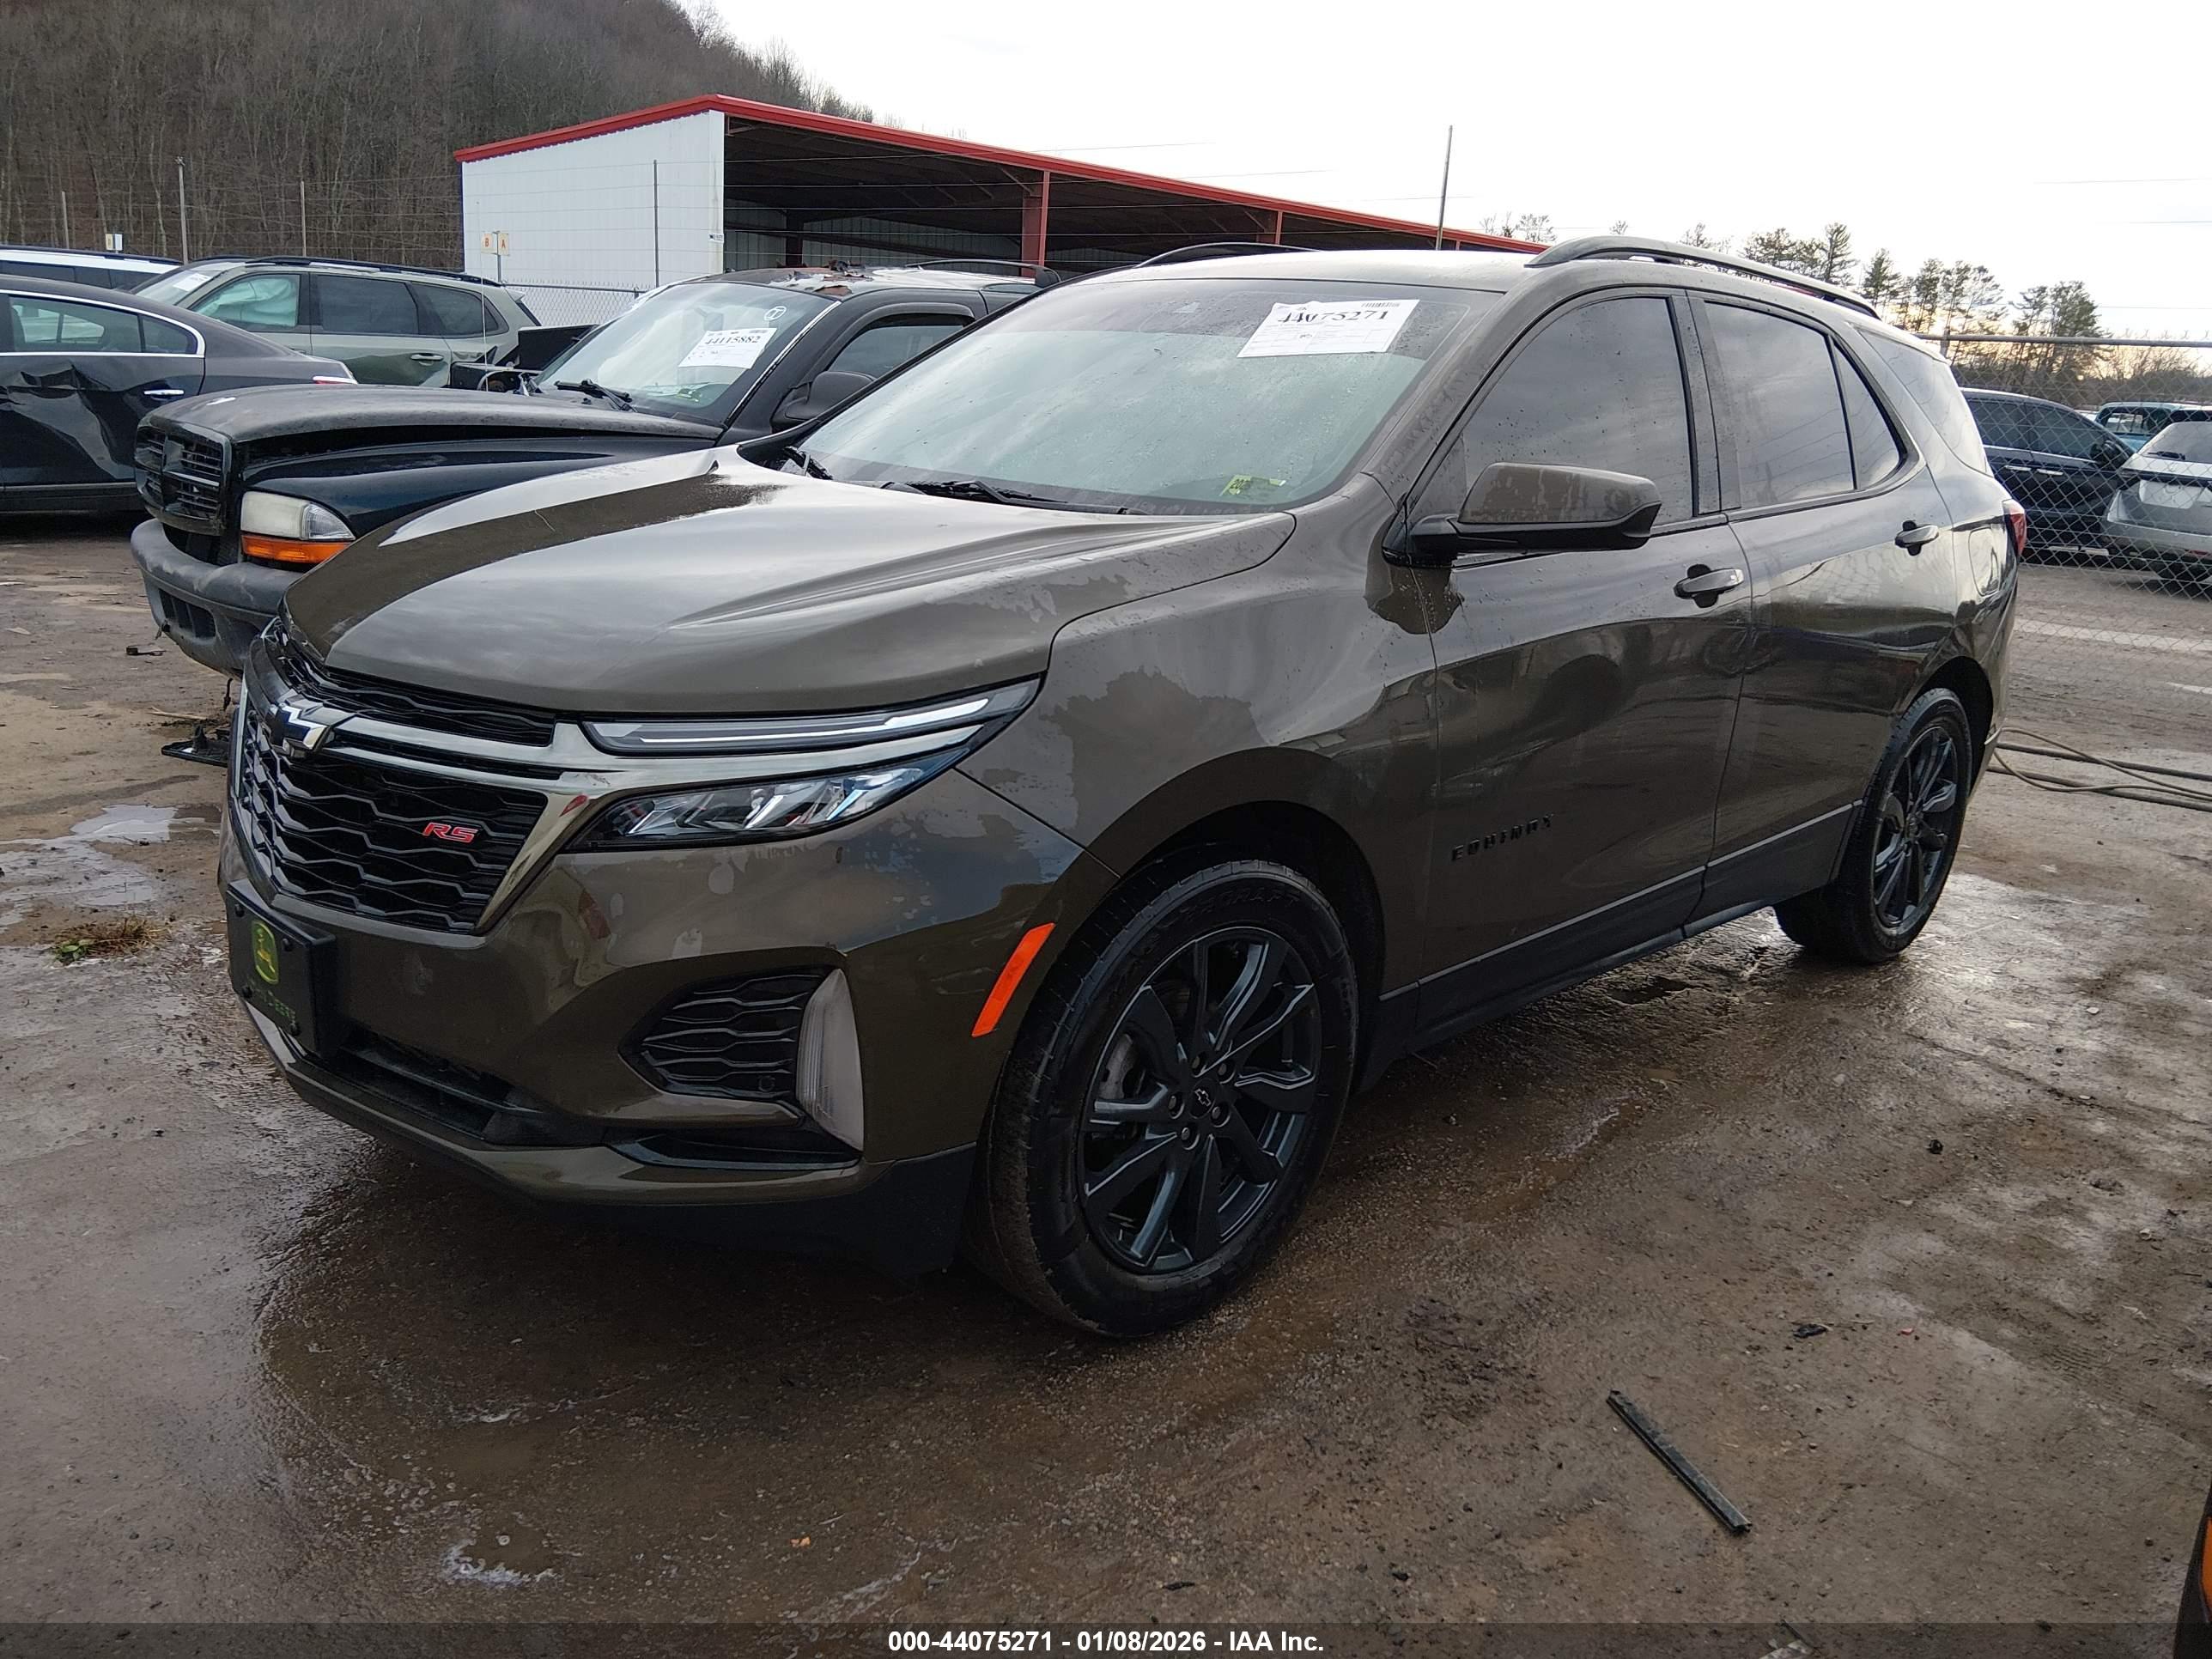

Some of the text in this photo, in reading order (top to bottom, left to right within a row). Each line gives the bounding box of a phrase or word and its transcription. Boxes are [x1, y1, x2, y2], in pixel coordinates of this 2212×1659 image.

[1277, 309, 1389, 324] 44075271
[422, 822, 478, 843] RS
[1451, 812, 1554, 861] EQUINOX
